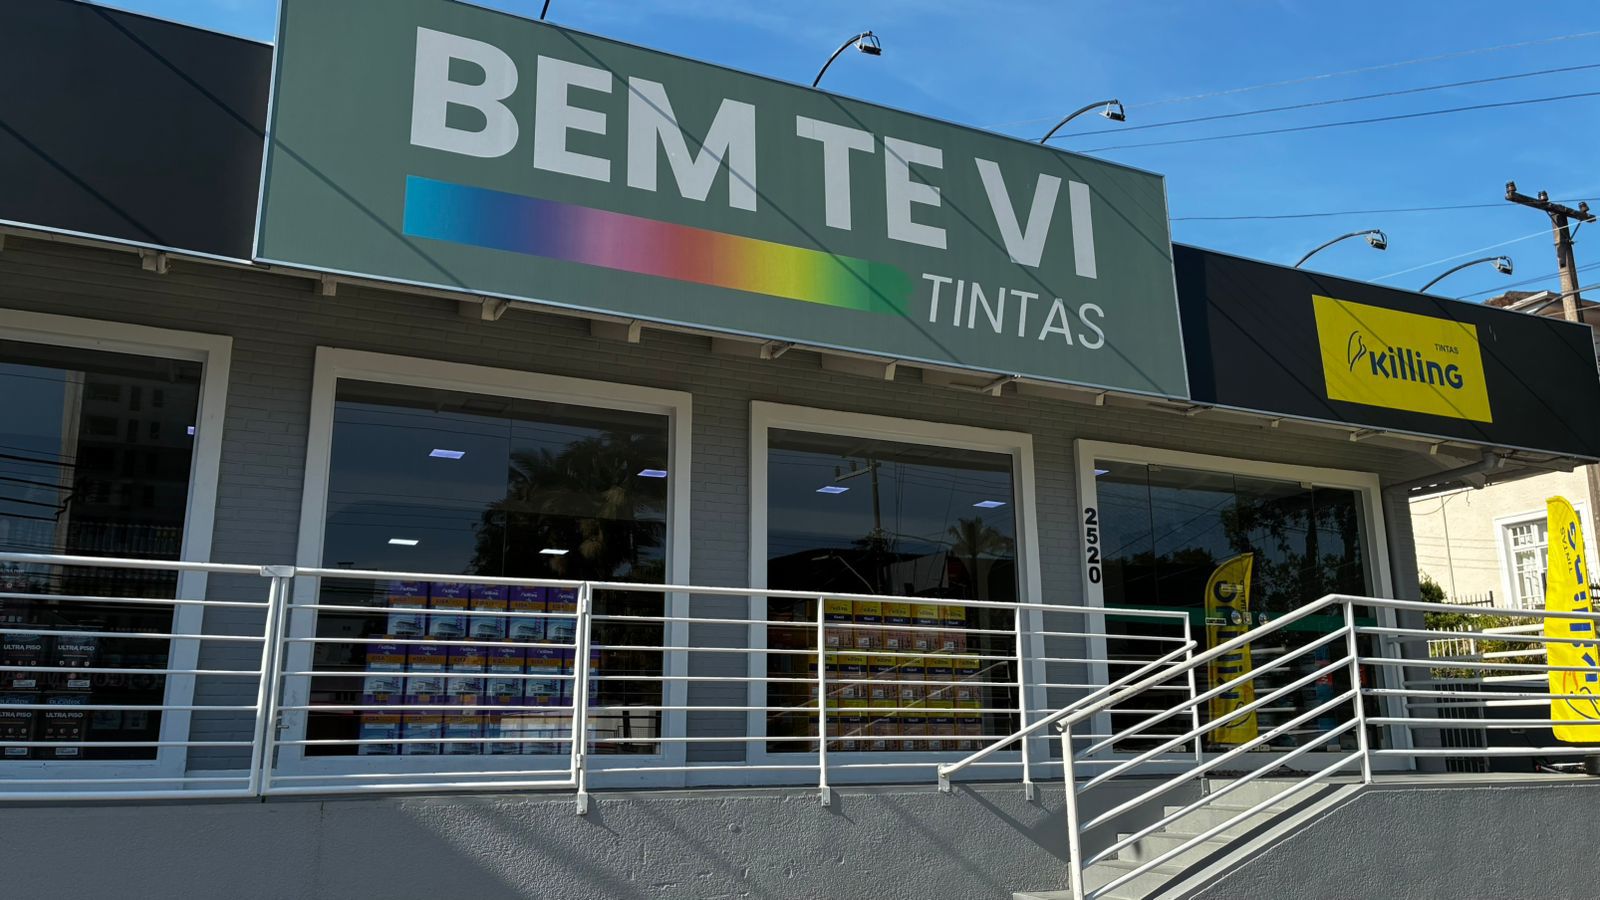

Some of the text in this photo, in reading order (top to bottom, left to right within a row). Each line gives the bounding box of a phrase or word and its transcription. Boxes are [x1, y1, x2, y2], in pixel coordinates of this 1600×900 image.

[410, 26, 1098, 280] BEM TE VI
[922, 273, 1105, 350] TINTAS
[1434, 343, 1460, 355] TINTAS
[1084, 507, 1102, 584] 2520
[1560, 526, 1575, 575] TINTAS
